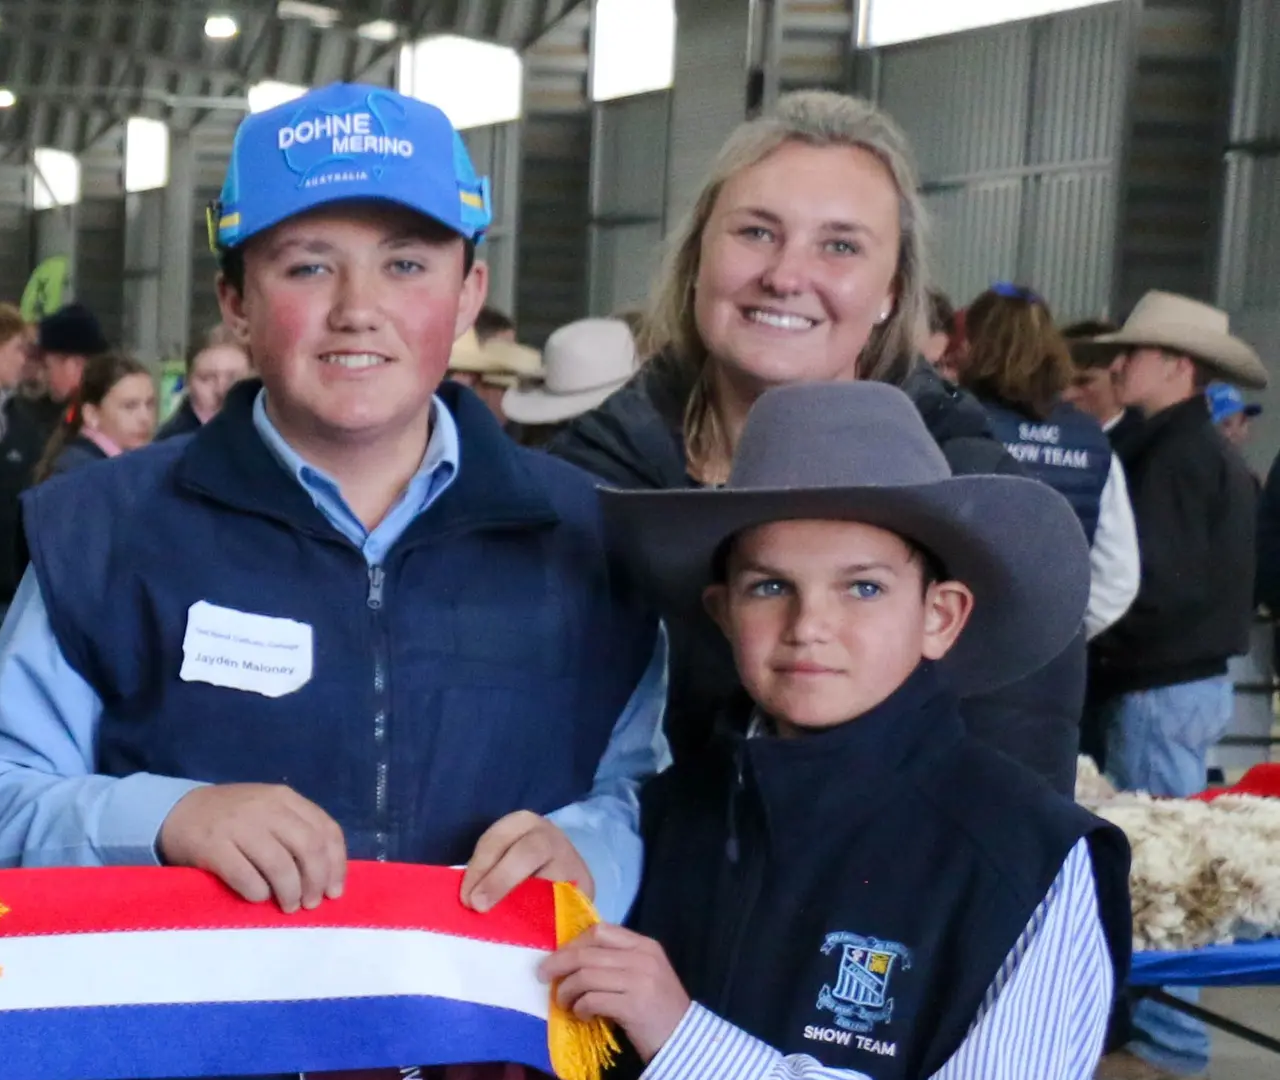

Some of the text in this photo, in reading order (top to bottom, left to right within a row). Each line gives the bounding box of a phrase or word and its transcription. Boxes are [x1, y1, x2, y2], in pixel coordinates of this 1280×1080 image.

[278, 113, 371, 149] DOHNE
[332, 135, 414, 158] MERINO
[1043, 446, 1089, 469] TEAM
[803, 1025, 897, 1057] SHOW TEAM
